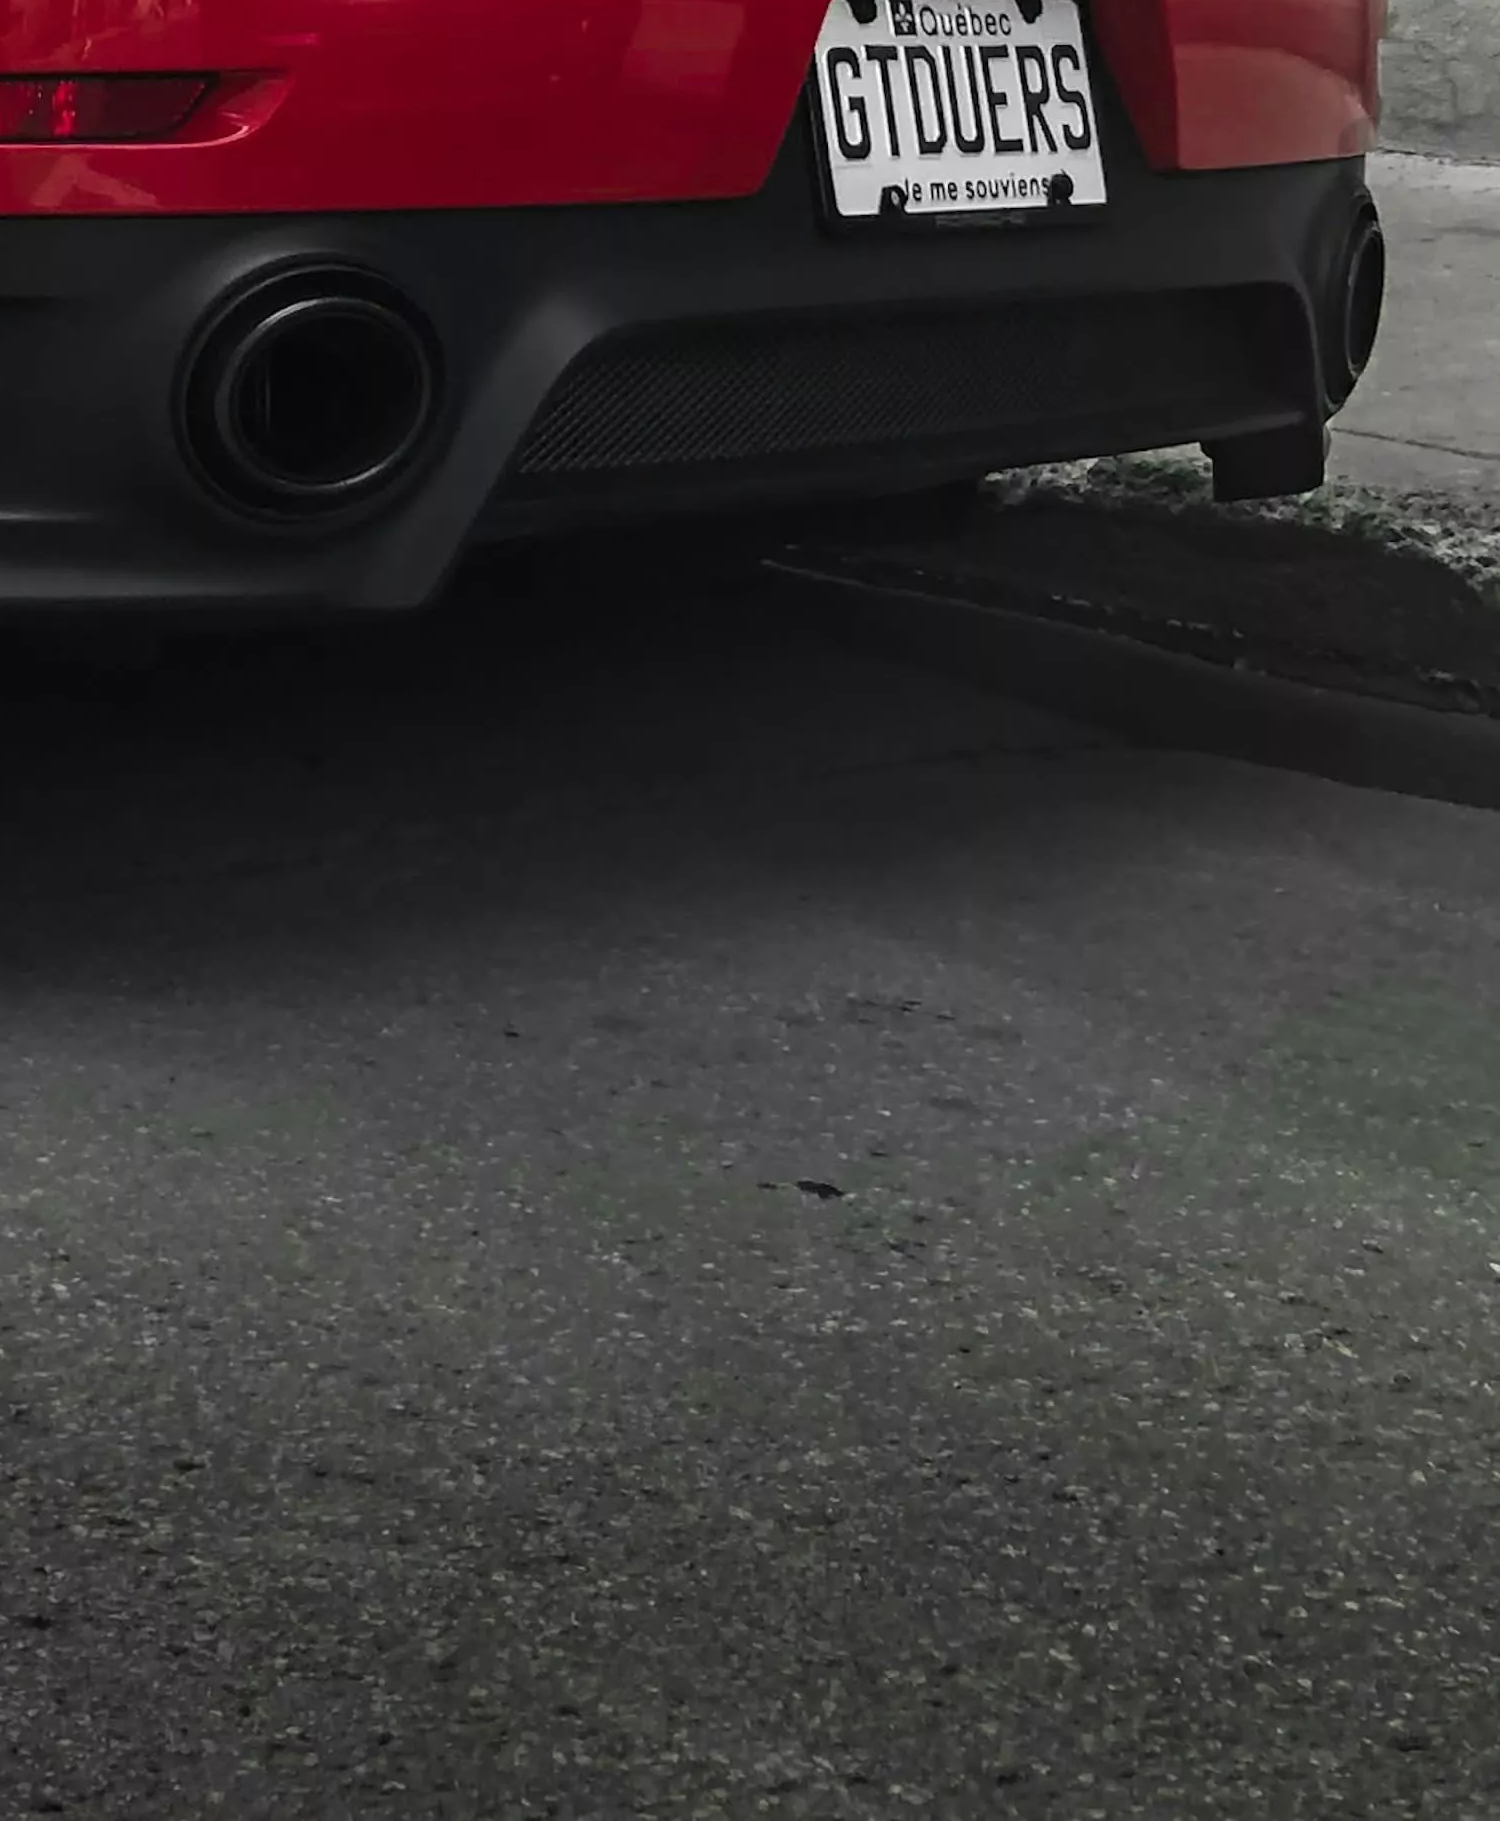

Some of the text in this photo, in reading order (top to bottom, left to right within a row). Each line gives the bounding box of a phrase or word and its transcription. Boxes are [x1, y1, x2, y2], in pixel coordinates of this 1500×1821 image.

[919, 3, 1012, 37] Québec
[826, 44, 1091, 159] GTDUERS
[930, 182, 958, 201] me
[965, 172, 1050, 199] souviens
